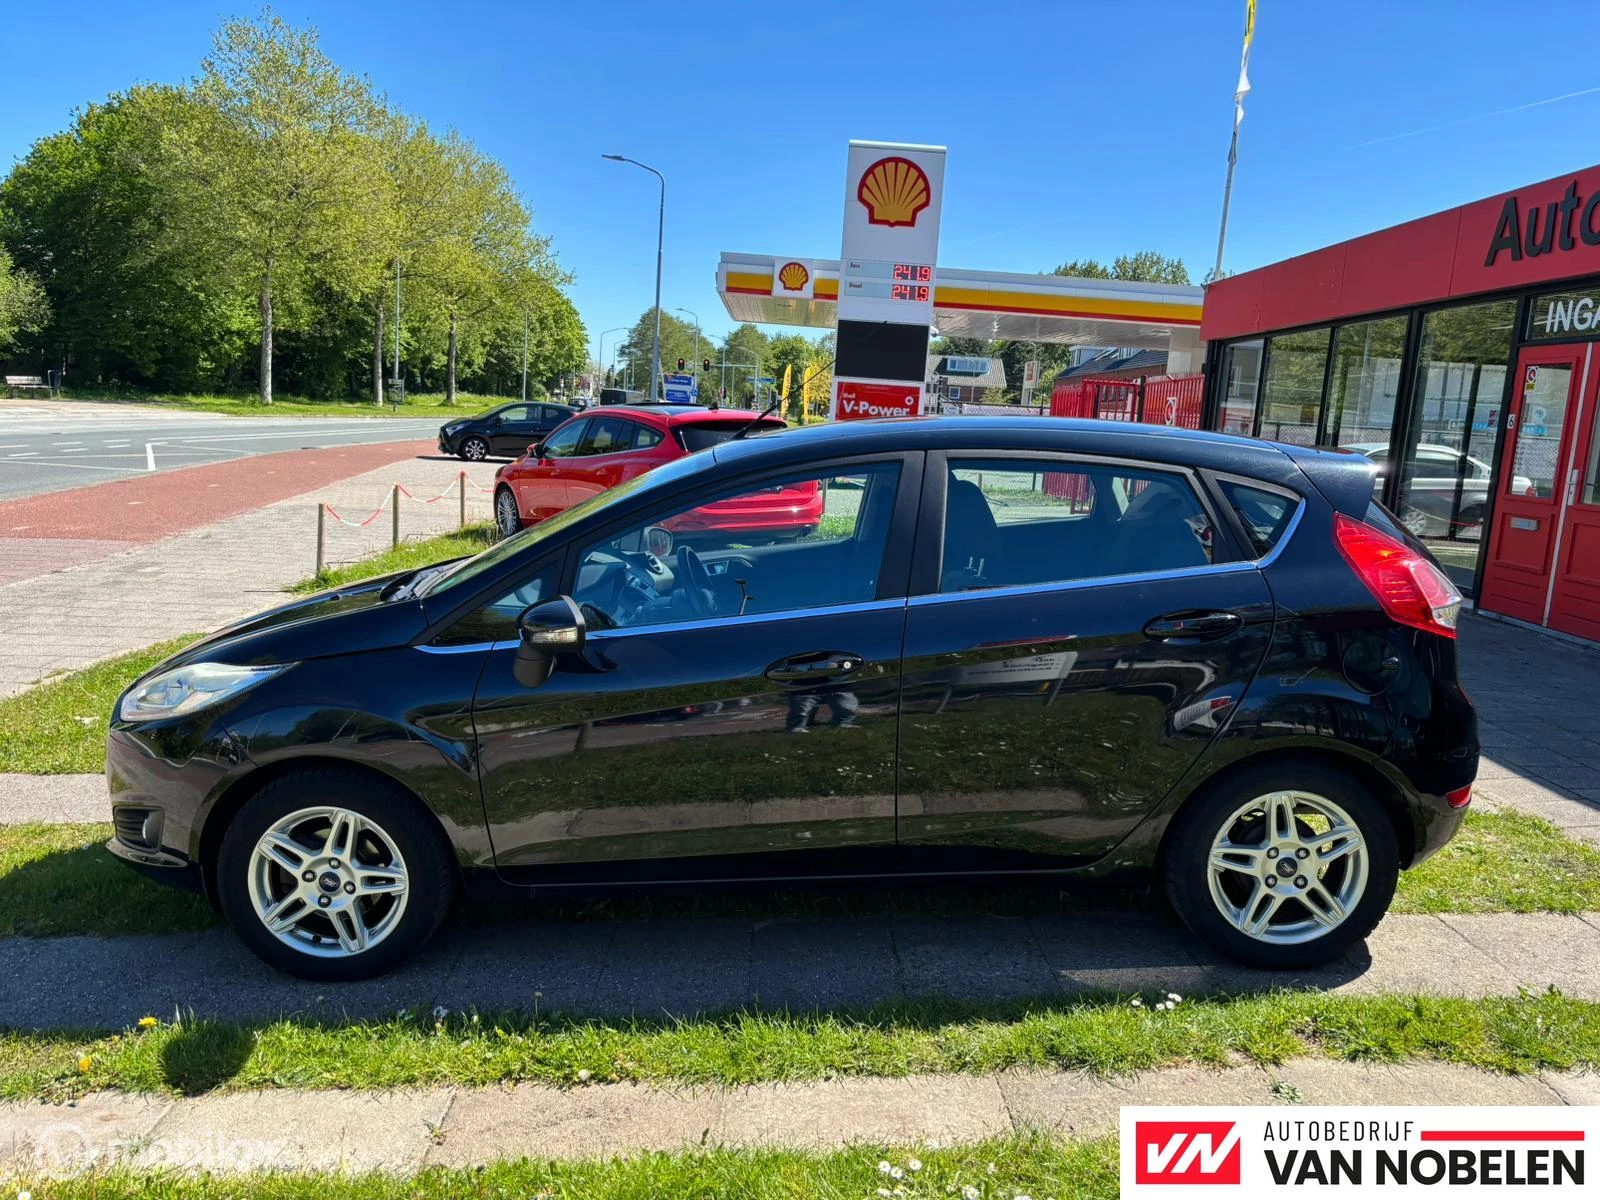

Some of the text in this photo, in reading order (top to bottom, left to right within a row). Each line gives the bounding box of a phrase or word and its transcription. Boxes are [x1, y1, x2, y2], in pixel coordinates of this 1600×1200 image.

[1484, 180, 1600, 267] Auto
[842, 400, 910, 416] V-Power
[1508, 416, 1515, 428] 6
